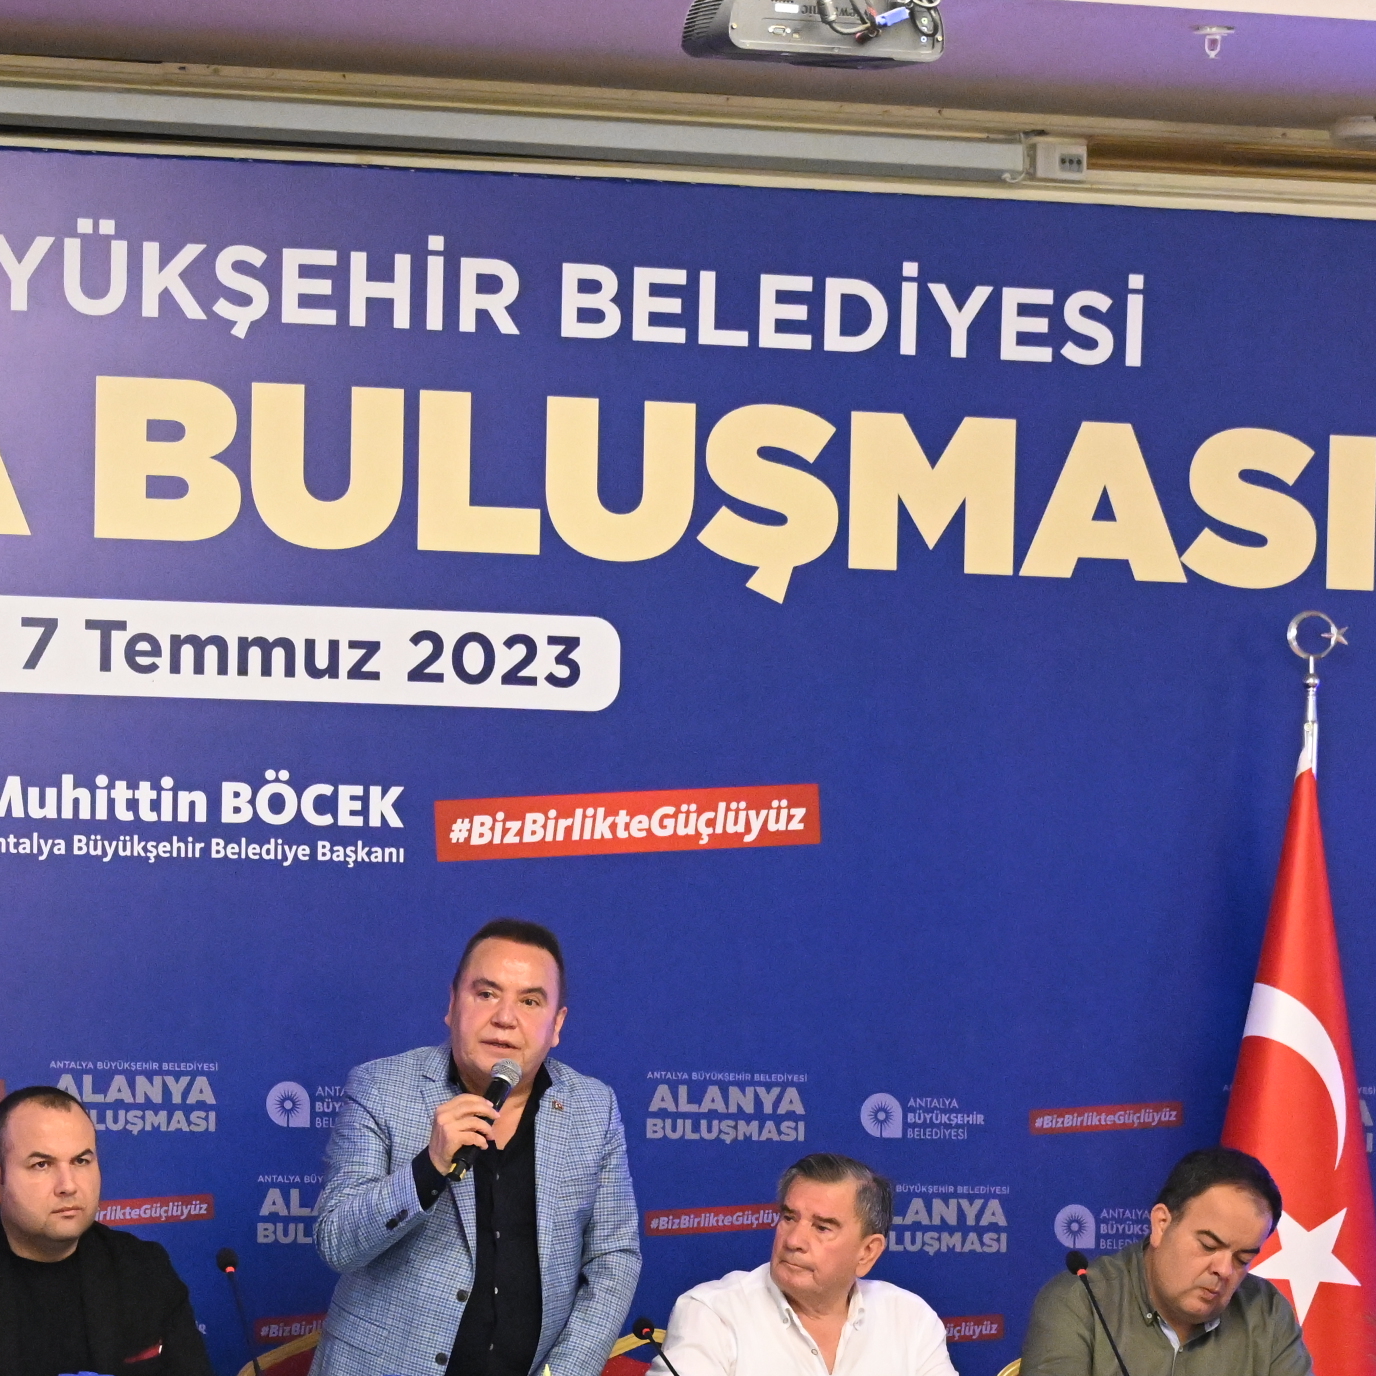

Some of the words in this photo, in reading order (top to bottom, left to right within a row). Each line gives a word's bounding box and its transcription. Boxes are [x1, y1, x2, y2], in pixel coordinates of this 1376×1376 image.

[561, 262, 1144, 366] BELEDİYESİ
[95, 374, 1376, 603] BULUŞMASI
[21, 617, 58, 669] 7
[85, 619, 381, 681] Temmuz
[408, 630, 580, 688] 2023
[221, 769, 403, 827] BÖCEK
[450, 799, 806, 845] #BizBirlikteGüçlüyüz
[73, 835, 204, 863] Büyükşehir
[211, 838, 310, 866] Belediye
[318, 840, 404, 867] Başkanı
[49, 1060, 94, 1070] ANTALYA
[96, 1060, 160, 1071] BÜYÜKŞEHİR
[161, 1061, 219, 1072] BELEDİYESİ
[646, 1071, 689, 1080] ANTALYA
[691, 1070, 752, 1082] BÜYÜKŞEHİR
[753, 1072, 808, 1083] BELEDİYESİ
[56, 1074, 217, 1105] ALANYA
[649, 1084, 805, 1114] ALANYA
[907, 1097, 959, 1109] ANTALYA
[85, 1109, 216, 1135] LUŞMASI
[646, 1118, 804, 1144] BULUŞMASI
[908, 1111, 984, 1127] BÜYÜKŞEHİR
[1035, 1109, 1176, 1128] #BizBirlikteGüçlüyüz
[907, 1126, 967, 1140] BELEDİYESİ
[257, 1174, 301, 1184] ANTALYA
[895, 1183, 955, 1195] BÜYÜKŞEHİR
[956, 1185, 1010, 1195] BELEDİYESİ
[648, 1208, 780, 1232] #BizBirlikteGüçlüy
[891, 1197, 1009, 1227] ANYA
[1098, 1206, 1151, 1221] ANTALYA
[888, 1230, 1008, 1256] LUŞMASI
